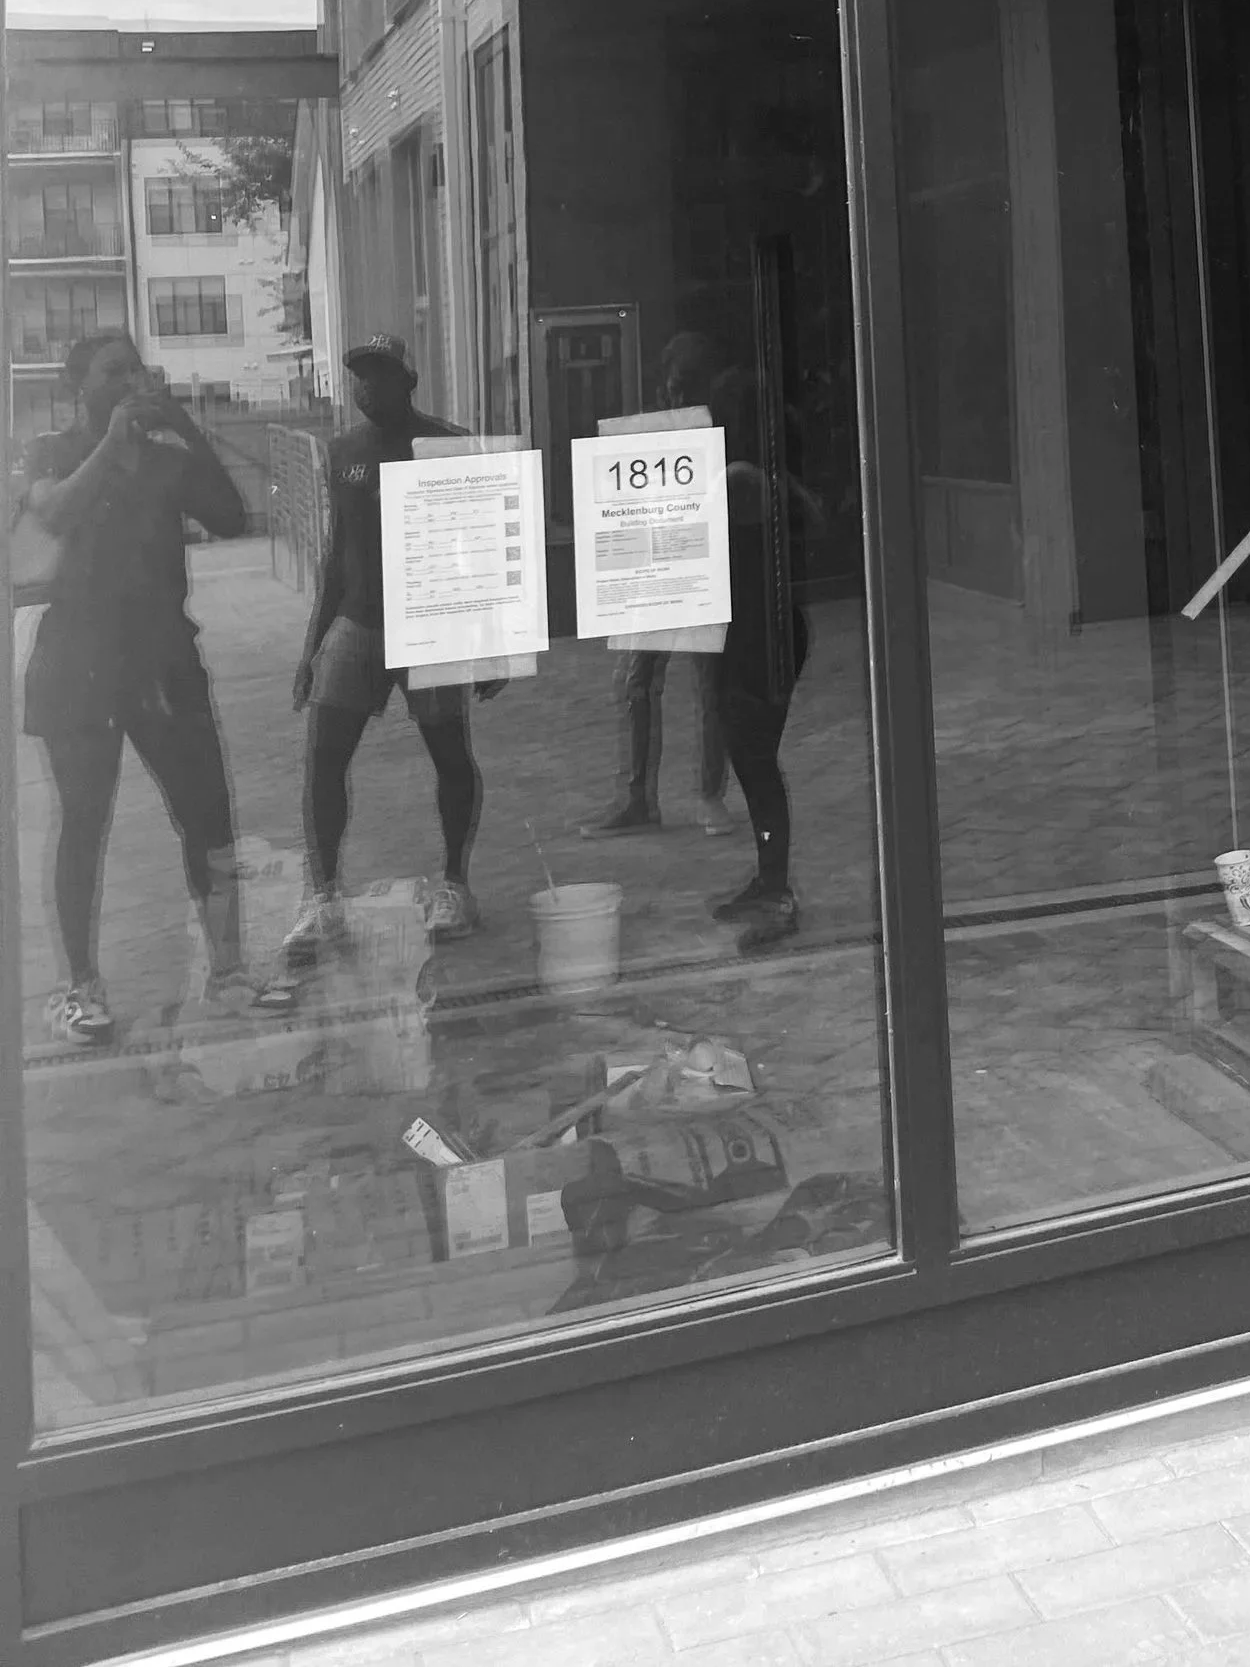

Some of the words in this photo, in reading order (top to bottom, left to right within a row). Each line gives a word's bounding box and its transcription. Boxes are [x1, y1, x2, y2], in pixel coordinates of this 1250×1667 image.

[418, 476, 463, 489] Inspection
[464, 472, 508, 485] Approvals
[609, 455, 693, 490] 1816
[602, 506, 664, 518] Mecklenburg
[666, 501, 701, 513] County
